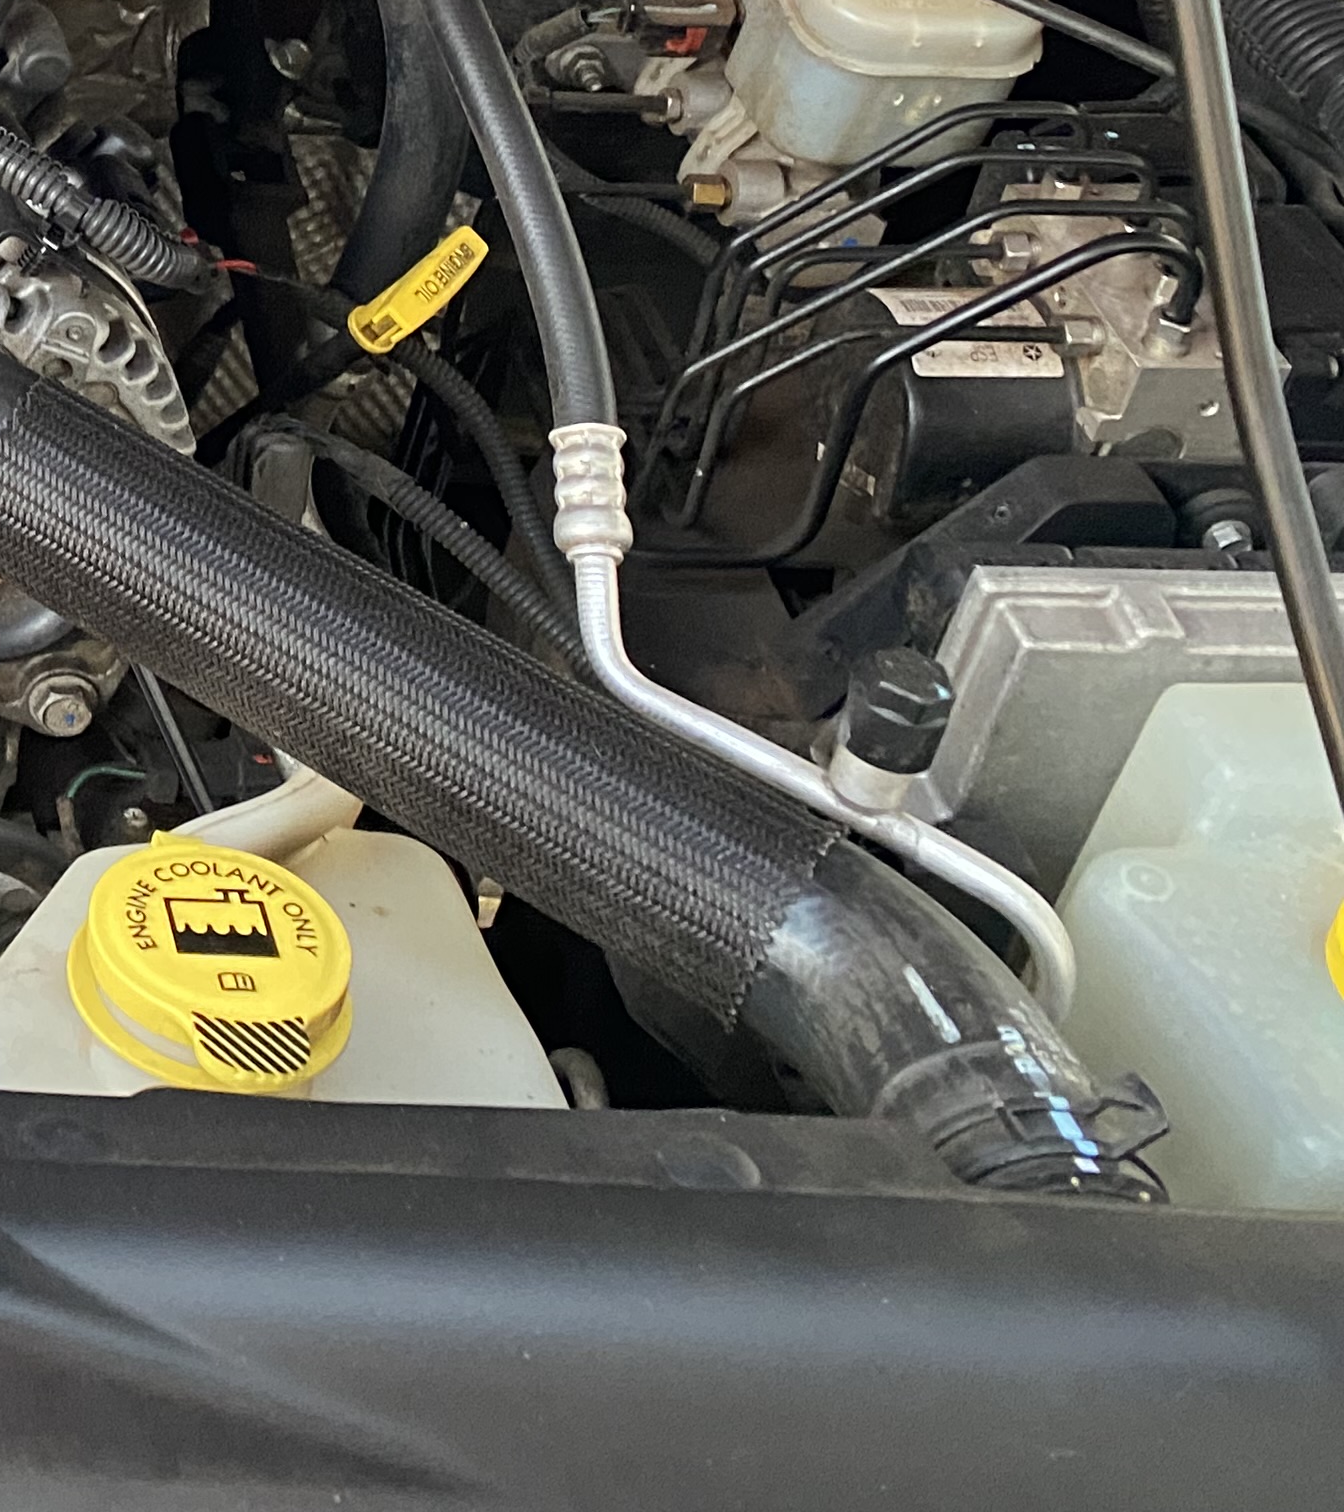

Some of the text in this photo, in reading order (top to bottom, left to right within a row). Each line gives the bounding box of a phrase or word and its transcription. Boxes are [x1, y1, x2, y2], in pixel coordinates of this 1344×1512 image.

[414, 242, 475, 304] ENGINE OIL
[126, 860, 318, 958] ENGINE COOLANT ONLY
